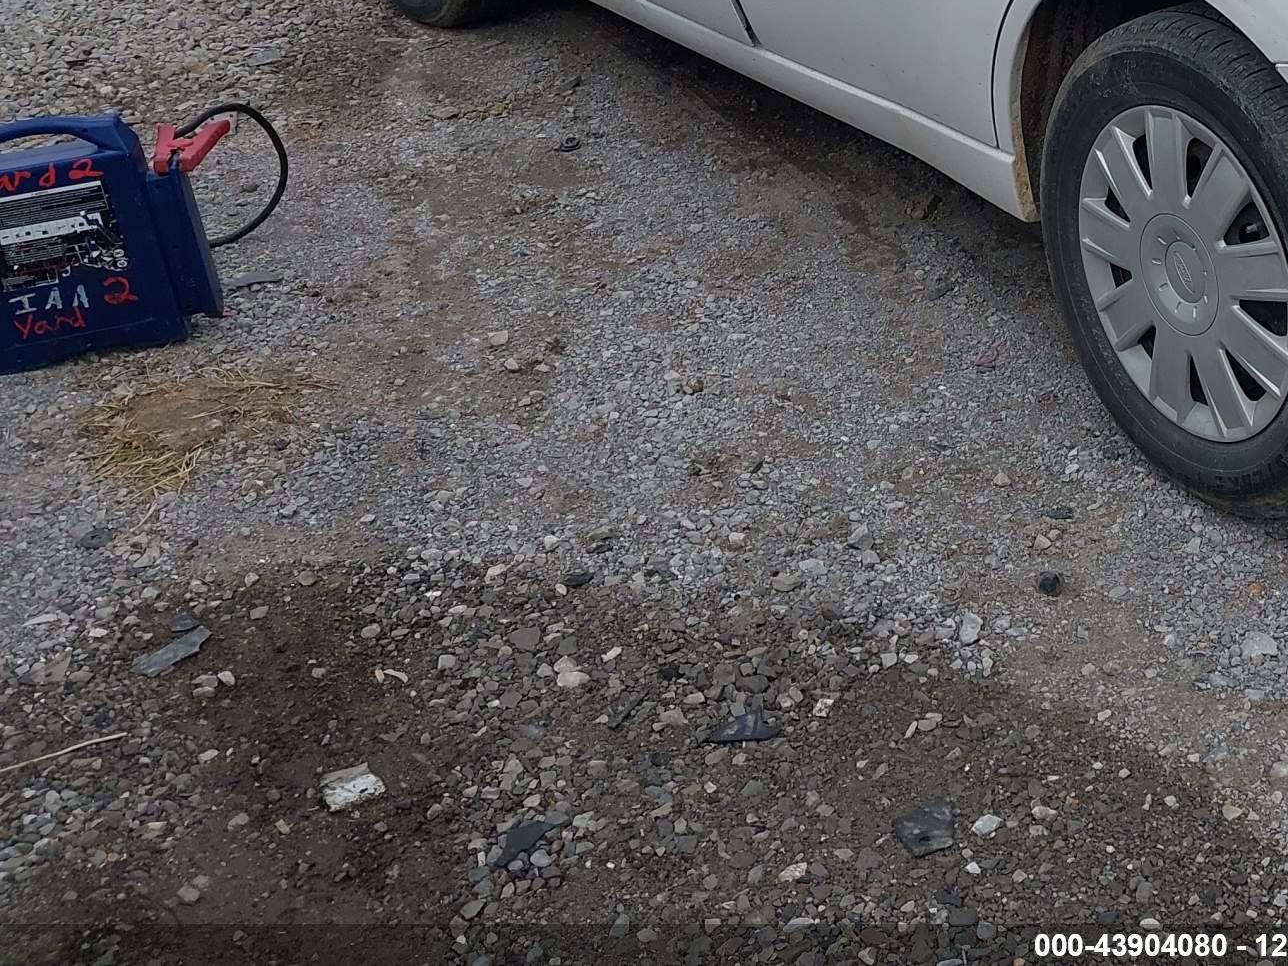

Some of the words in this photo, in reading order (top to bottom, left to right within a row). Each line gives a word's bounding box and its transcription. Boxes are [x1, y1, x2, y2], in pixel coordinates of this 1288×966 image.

[68, 158, 104, 179] 2
[13, 306, 86, 340] Yard
[103, 276, 139, 304] 2
